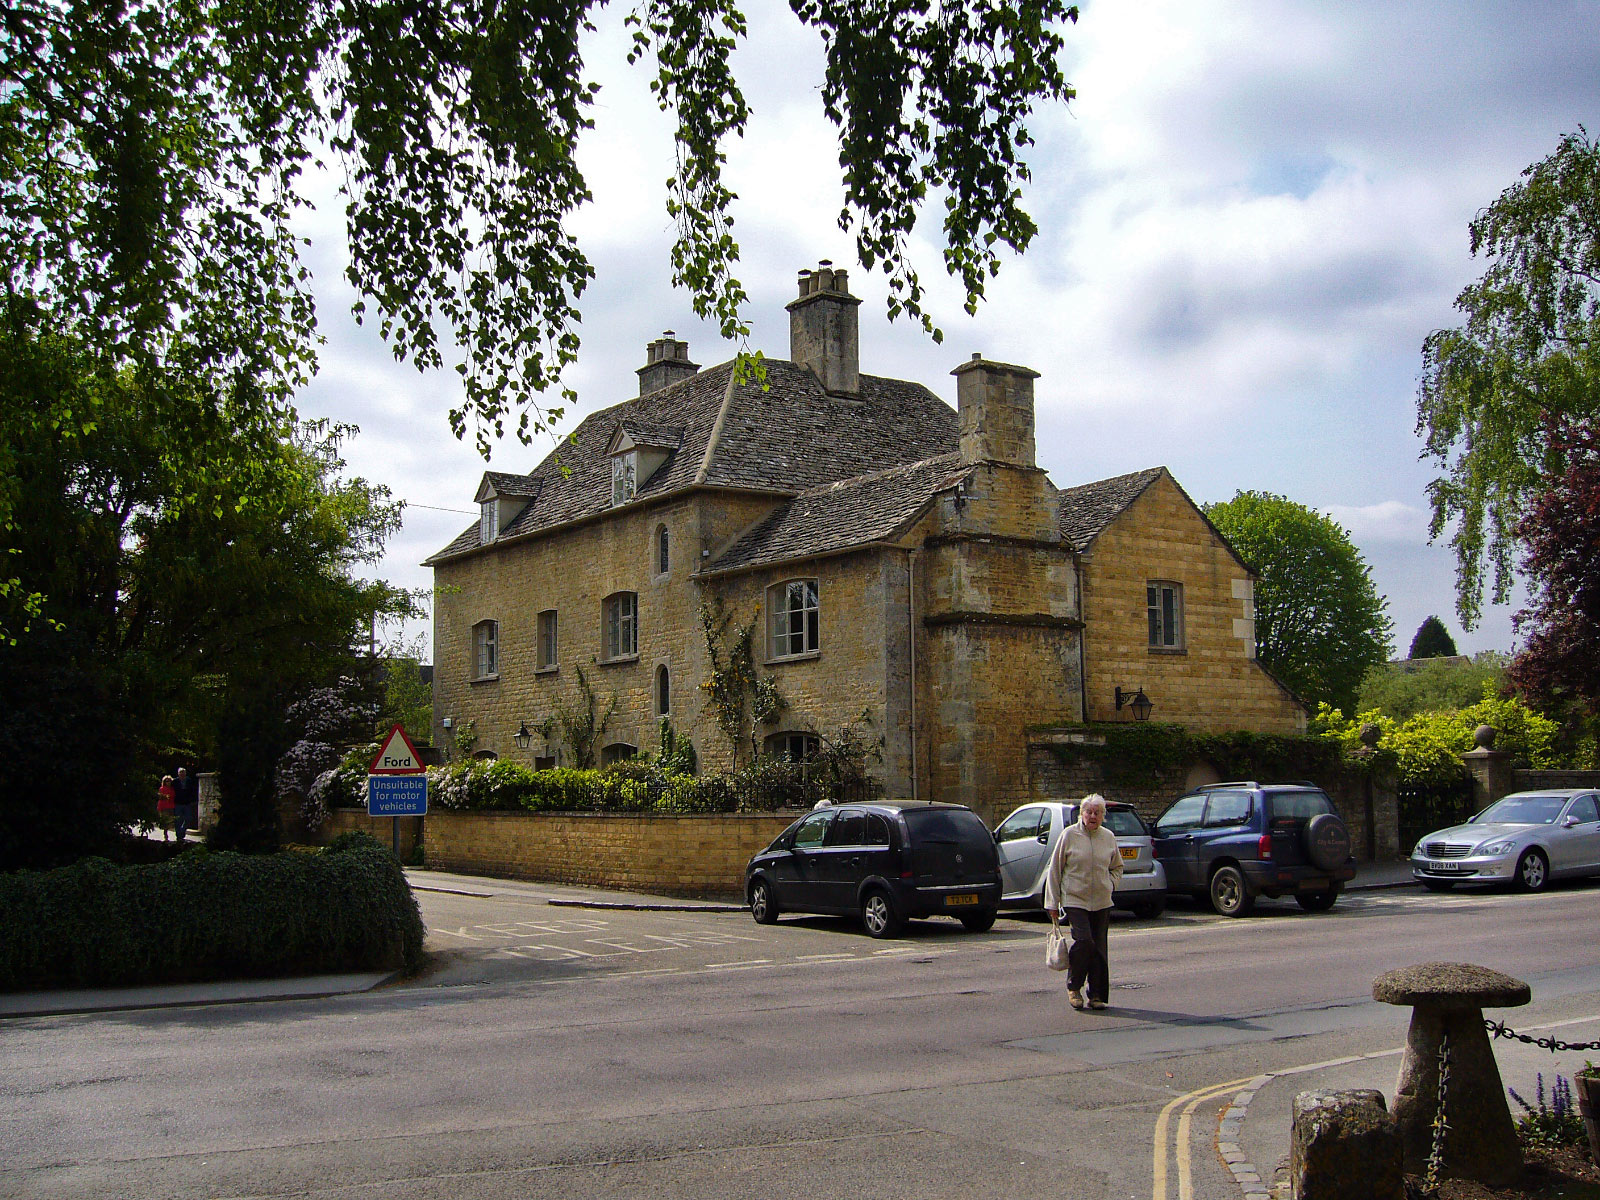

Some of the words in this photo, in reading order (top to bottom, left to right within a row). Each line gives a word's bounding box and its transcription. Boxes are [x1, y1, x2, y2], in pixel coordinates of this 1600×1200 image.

[384, 756, 411, 767] Ford
[373, 780, 423, 789] Unsuitable
[376, 791, 389, 800] for
[392, 791, 420, 800] motor
[379, 801, 417, 811] vehicles
[433, 919, 610, 941] KEEP
[501, 931, 766, 960] CLEAR
